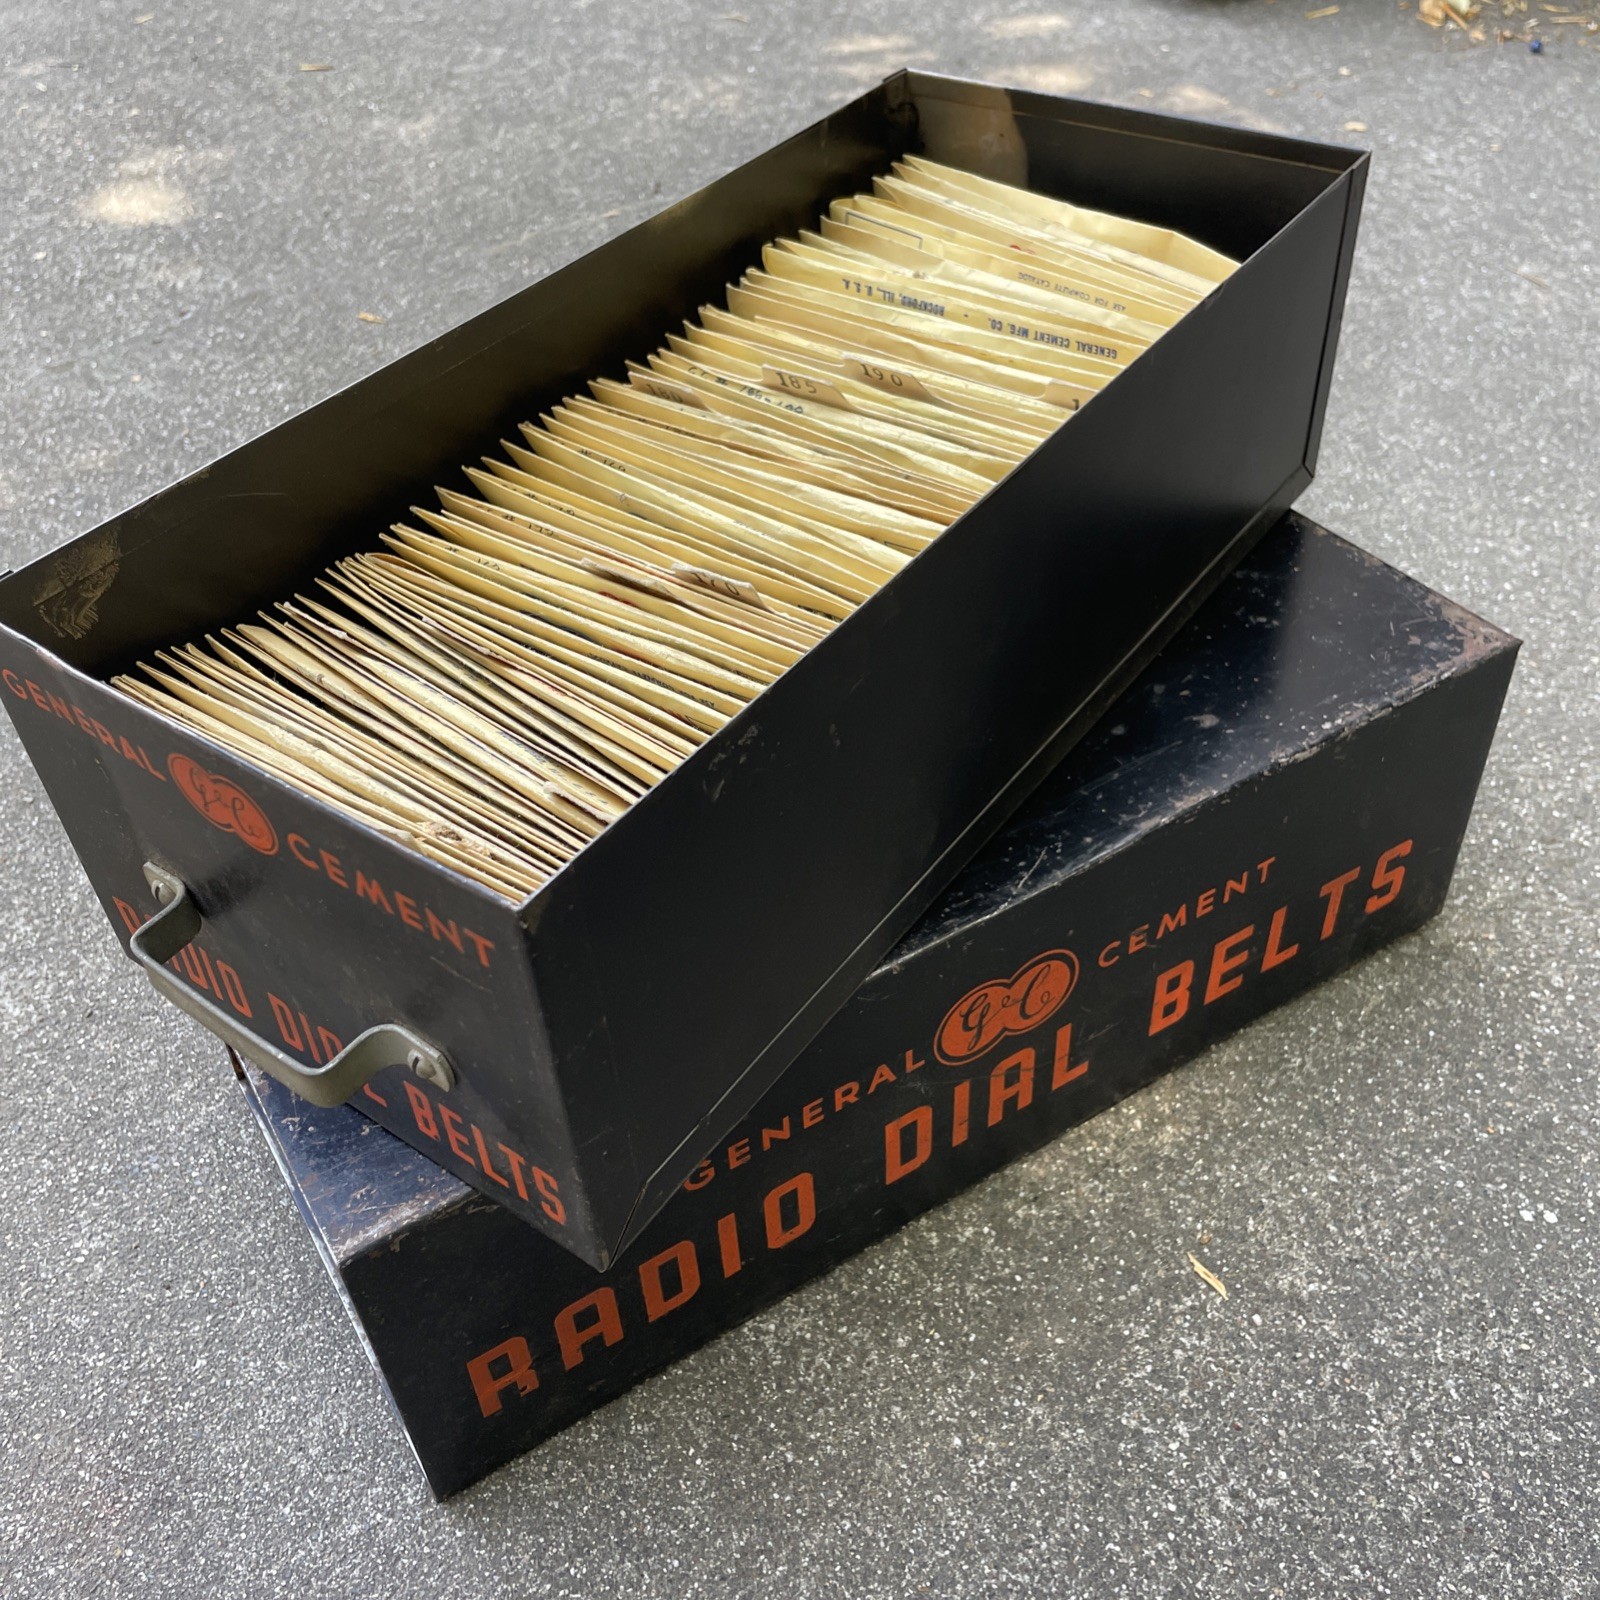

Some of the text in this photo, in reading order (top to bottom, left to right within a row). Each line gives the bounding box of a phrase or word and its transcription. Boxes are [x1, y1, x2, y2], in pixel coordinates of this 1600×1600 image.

[1017, 272, 1051, 288] CATALOG
[988, 317, 1003, 332] CO.
[1007, 322, 1029, 339] MFG.
[1034, 330, 1070, 349] CEMENT
[1075, 340, 1118, 360] GENERAL
[775, 372, 818, 395] 185
[860, 363, 904, 388] 190
[2, 668, 168, 782] GENERAL
[287, 832, 496, 969] CEMENT
[683, 1049, 926, 1192] GENERAL
[1098, 856, 1277, 969] CEMENT
[112, 896, 254, 1019] RDIO
[403, 1081, 568, 1225] BELTS
[466, 839, 1414, 1417] RADIO DIAL BELTS
